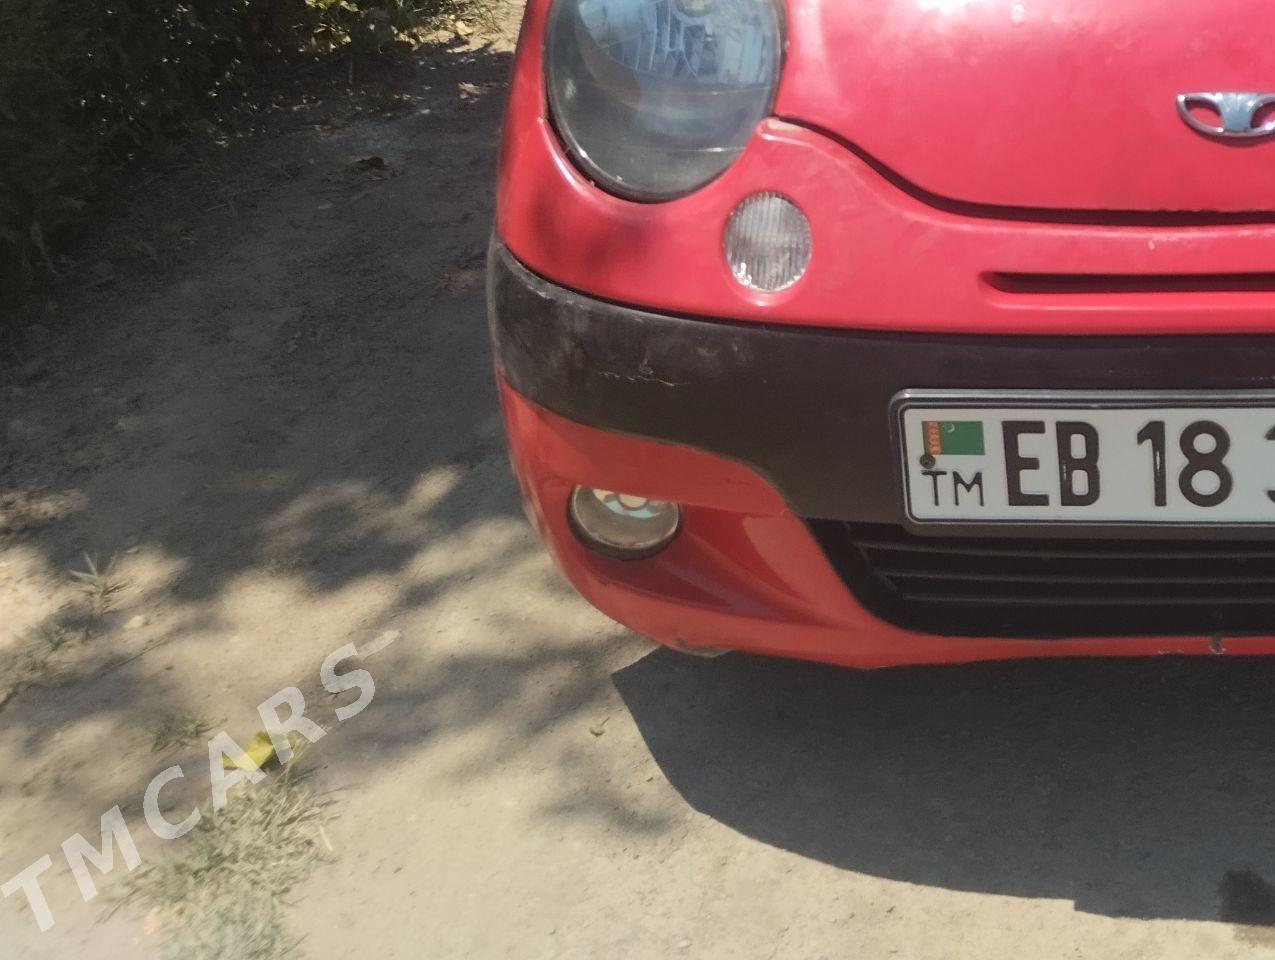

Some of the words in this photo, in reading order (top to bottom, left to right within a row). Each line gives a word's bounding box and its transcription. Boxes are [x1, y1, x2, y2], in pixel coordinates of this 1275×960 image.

[921, 470, 985, 507] TM
[1002, 420, 1101, 507] EB
[1136, 420, 1234, 508] 18
